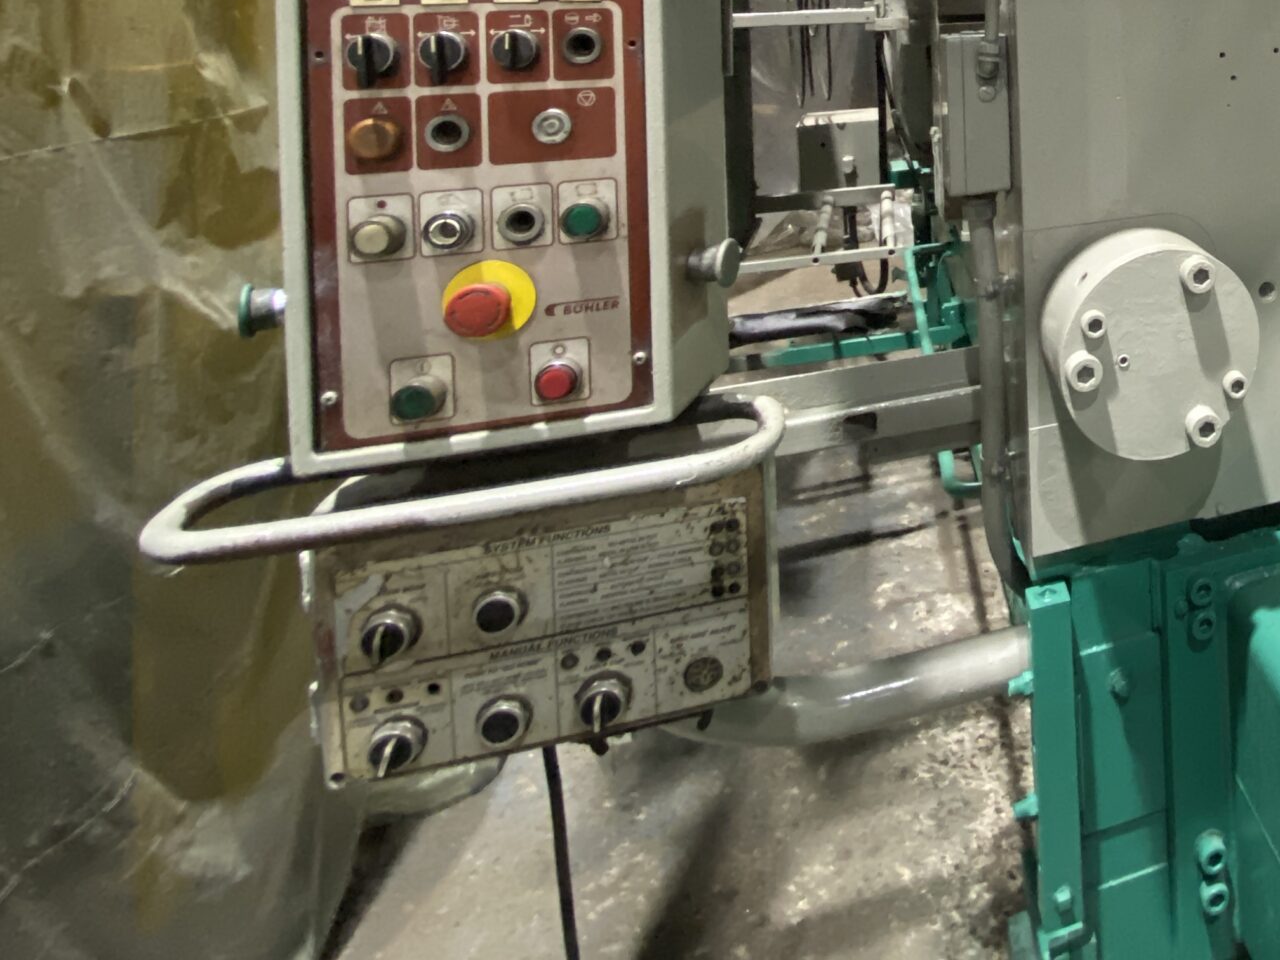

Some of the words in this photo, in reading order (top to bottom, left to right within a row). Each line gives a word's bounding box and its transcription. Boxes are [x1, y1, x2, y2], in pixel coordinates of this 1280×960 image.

[538, 524, 611, 545] FUNCTIONS
[489, 643, 542, 660] MANUAL
[546, 627, 618, 649] FUNCTIONS
